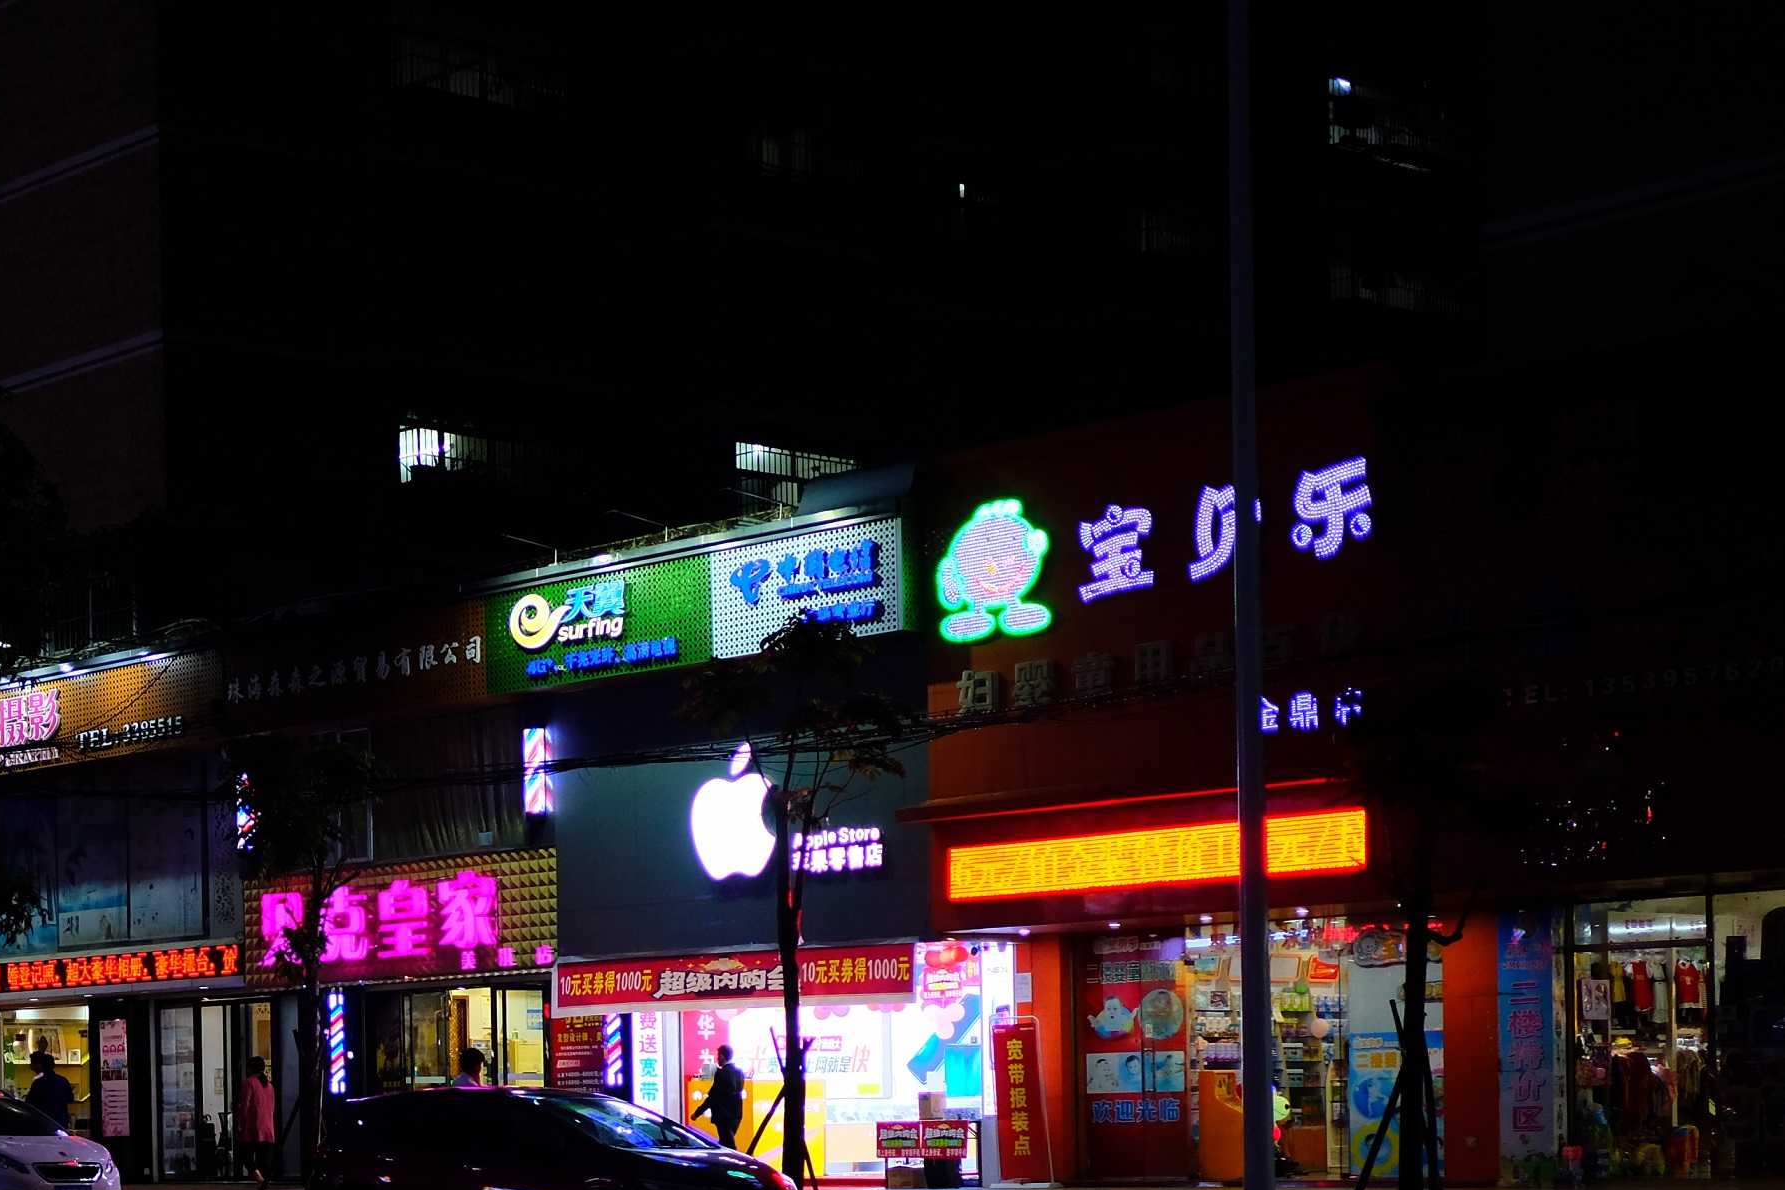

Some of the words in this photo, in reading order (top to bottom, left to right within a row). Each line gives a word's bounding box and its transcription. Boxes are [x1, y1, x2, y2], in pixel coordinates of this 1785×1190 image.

[561, 579, 626, 622] 天翼
[557, 617, 625, 643] surfing
[838, 826, 880, 844] Store
[256, 871, 500, 967] 贝克皇家
[560, 969, 653, 997] 10元买券得1000元
[653, 967, 786, 999] 超级内购会
[801, 956, 910, 984] 10元买券得1000元
[1506, 980, 1546, 1130] 二楼特价区
[1006, 1038, 1031, 1157] 宽带报装点
[1091, 1097, 1181, 1125] 欢迎光临
